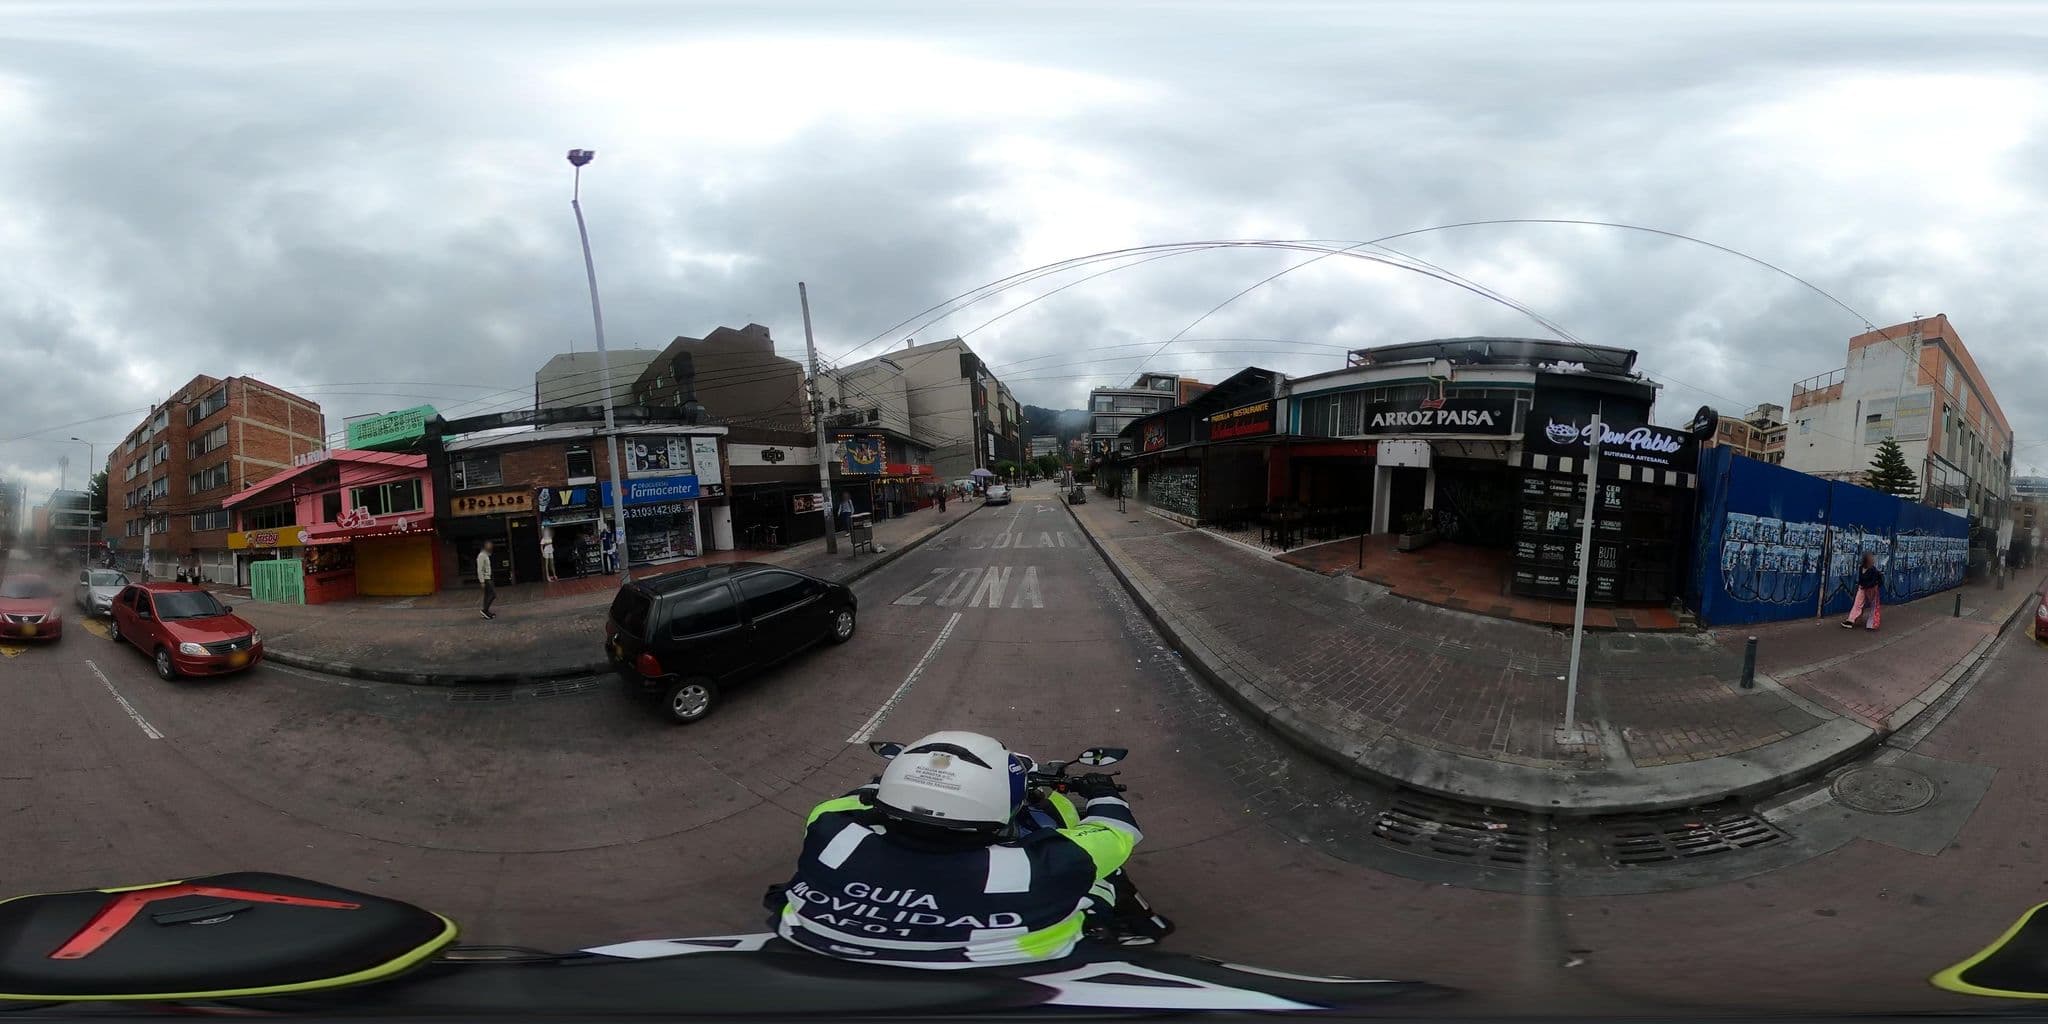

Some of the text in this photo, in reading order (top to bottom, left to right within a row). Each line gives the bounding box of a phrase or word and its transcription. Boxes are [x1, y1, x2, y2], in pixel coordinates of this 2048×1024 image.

[1232, 402, 1270, 417] RESTAURANTE
[1371, 410, 1495, 427] ARROZ PAISA
[1581, 423, 1681, 453] Don Pablo
[1604, 450, 1670, 465] BUTIFARRA ARTESANAL
[1599, 546, 1617, 559] BUTI
[889, 566, 1044, 608] ZONA
[793, 881, 1023, 928] MOVILIDAD
[843, 882, 939, 910] GUÍA
